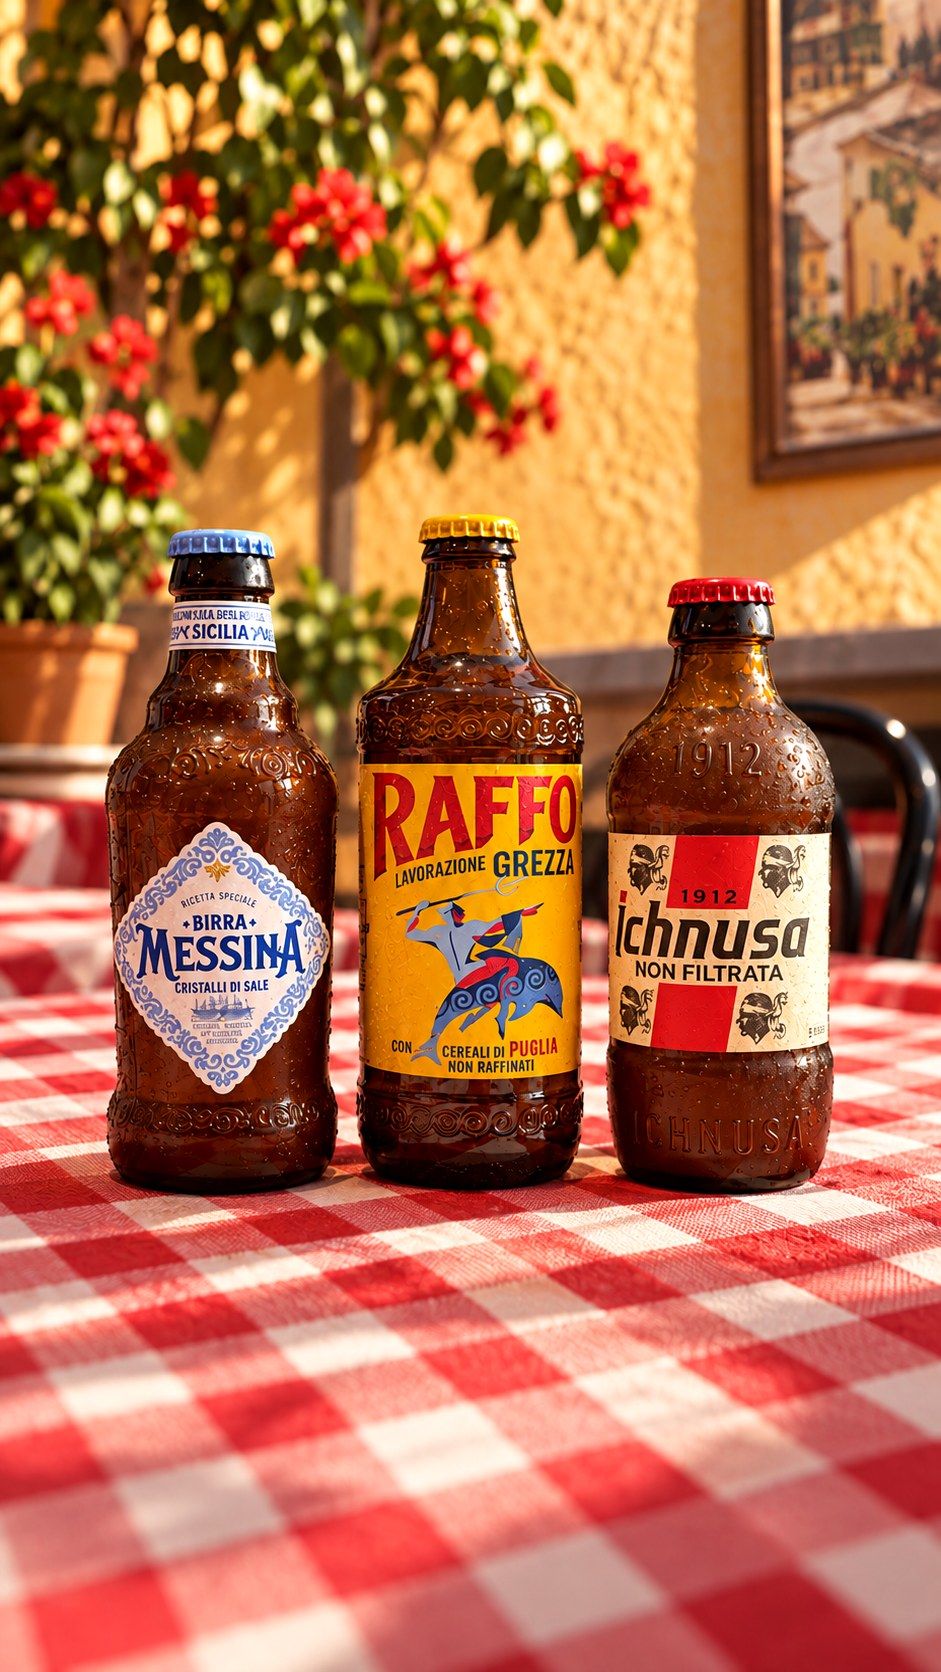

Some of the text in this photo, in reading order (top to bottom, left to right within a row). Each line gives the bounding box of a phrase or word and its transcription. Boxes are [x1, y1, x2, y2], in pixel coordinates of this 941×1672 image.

[192, 623, 249, 640] SICILIA
[672, 741, 763, 778] 1912
[372, 772, 577, 882] RAFFO
[395, 849, 574, 888] LAVORAZIONE GREZZA
[180, 891, 258, 908] RICETTA SPECIALE
[681, 889, 738, 904] 1912
[192, 914, 248, 931] BIRRA
[615, 890, 810, 960] ichnusa
[136, 919, 306, 981] MESSINA
[635, 960, 784, 983] NON FILTRATA
[175, 979, 269, 993] CRISTALLI DI SALE
[391, 1037, 558, 1058] CON CEREALI DI PUGLIA
[448, 1059, 535, 1073] NON RAFFINATI
[632, 1110, 804, 1156] ICHNUSA
